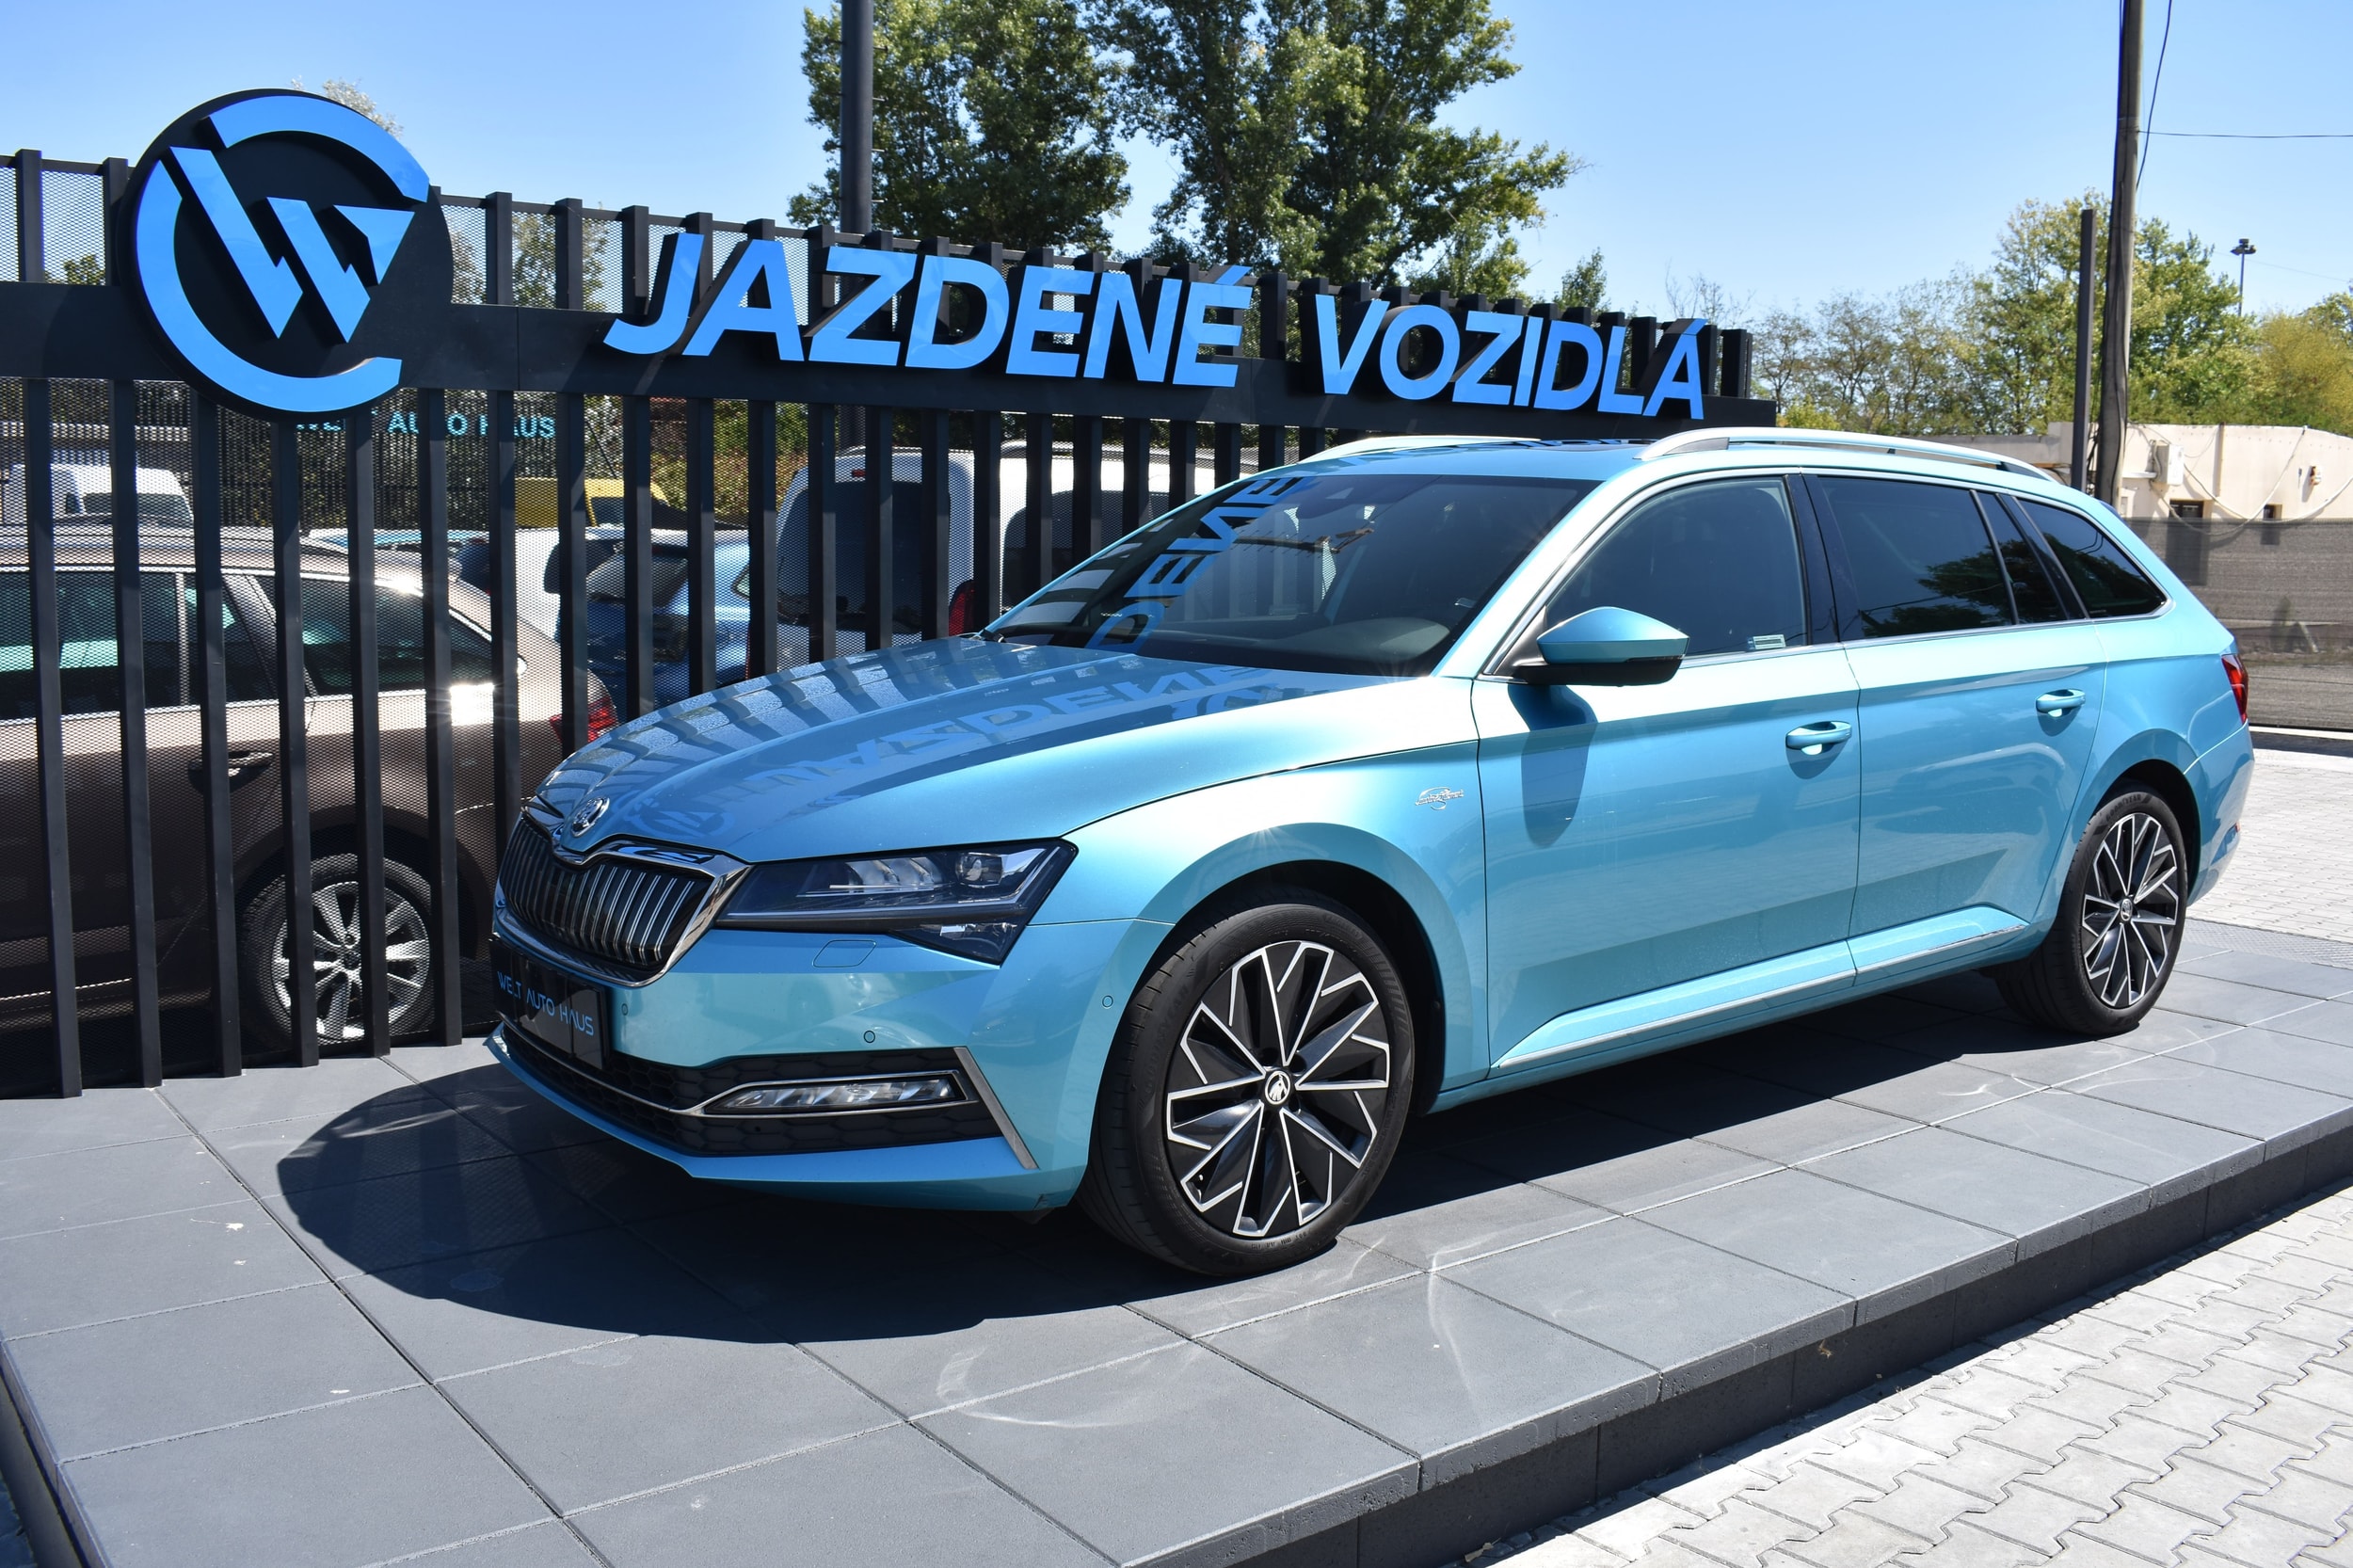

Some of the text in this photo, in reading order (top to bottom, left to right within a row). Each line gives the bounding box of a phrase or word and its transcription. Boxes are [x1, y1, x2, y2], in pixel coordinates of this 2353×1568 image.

[603, 232, 1707, 420] JAZDENÉ VOZIDLÁ
[387, 410, 468, 436] AUO
[526, 987, 555, 1017] AUTO
[559, 1002, 595, 1036] HAUS
